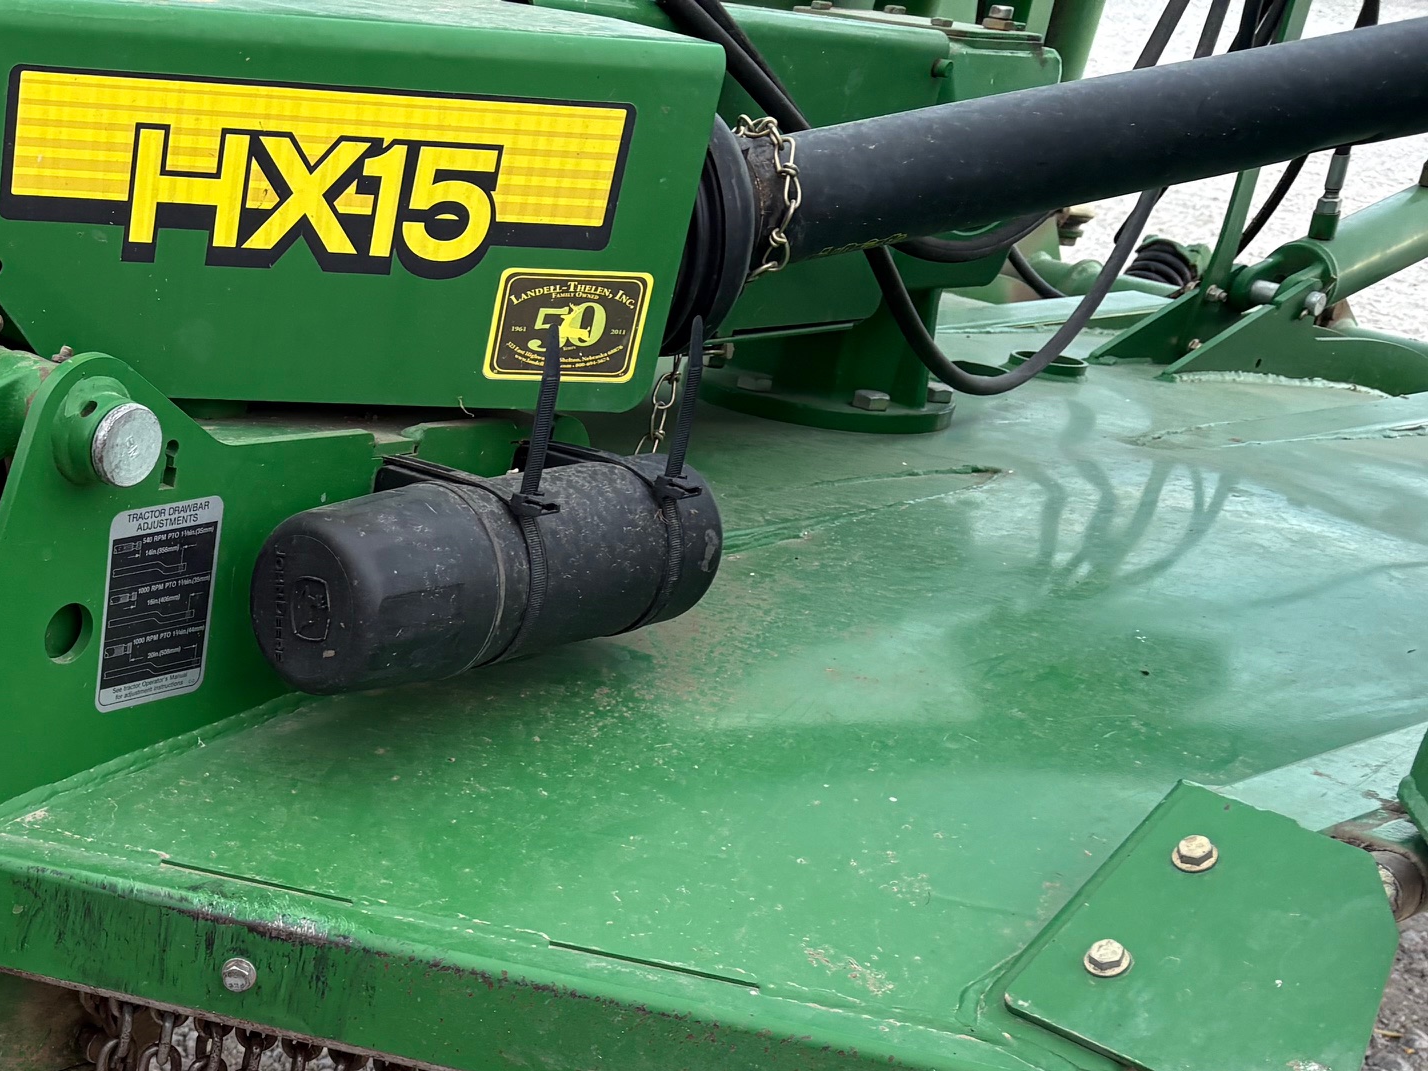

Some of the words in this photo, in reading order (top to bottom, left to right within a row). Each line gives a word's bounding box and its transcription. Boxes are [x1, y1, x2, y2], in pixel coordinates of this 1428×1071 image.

[126, 126, 504, 265] HX15
[527, 302, 606, 351] 50
[127, 508, 166, 523] TRACTOR
[168, 501, 210, 516] DRAWBAR
[136, 513, 198, 532] ADJUSTMENTS
[154, 534, 167, 542] RPM
[168, 532, 180, 540] PTO
[165, 581, 177, 589] PTO
[145, 634, 159, 642] RPM
[159, 631, 172, 640] PTO
